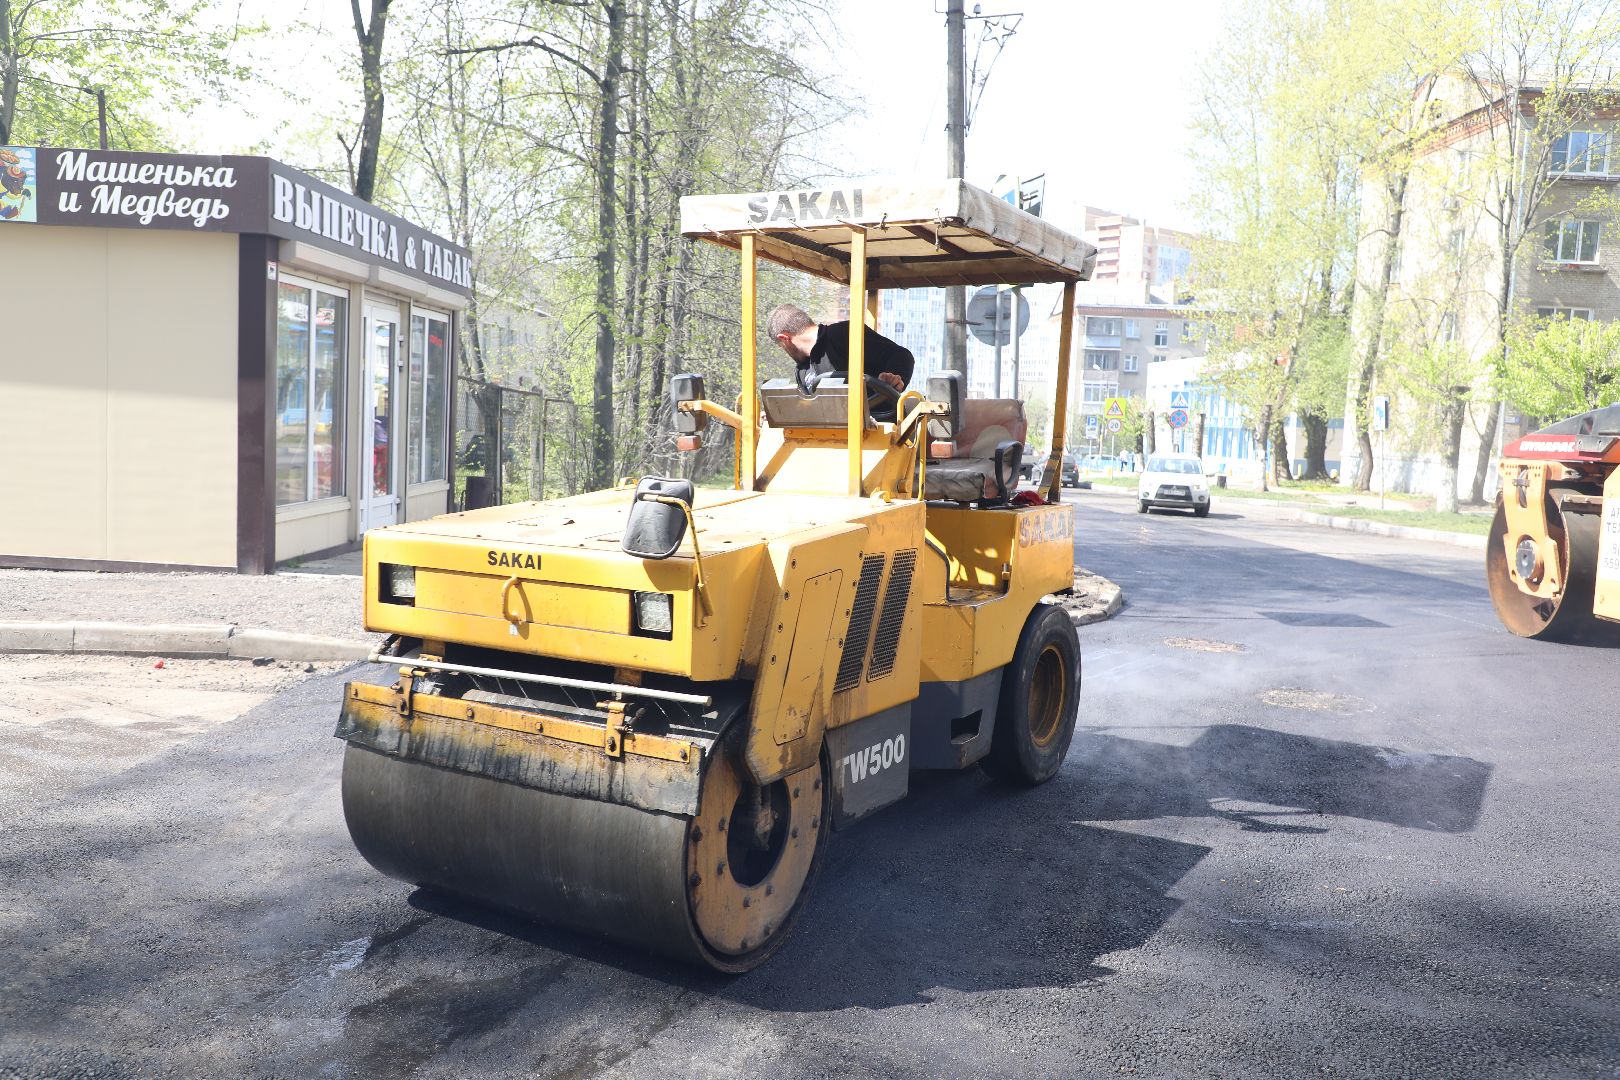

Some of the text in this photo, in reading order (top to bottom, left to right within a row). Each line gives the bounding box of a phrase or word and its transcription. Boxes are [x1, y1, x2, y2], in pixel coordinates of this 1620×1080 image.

[56, 151, 237, 188] Машенька
[58, 184, 230, 227] и Медведь
[748, 189, 863, 223] SAKAI
[273, 174, 472, 288] ВЫПЕЧКА & ТАБАК
[1019, 511, 1072, 548] SAKAI
[487, 550, 542, 571] SAKAI
[836, 734, 905, 788] TW500
